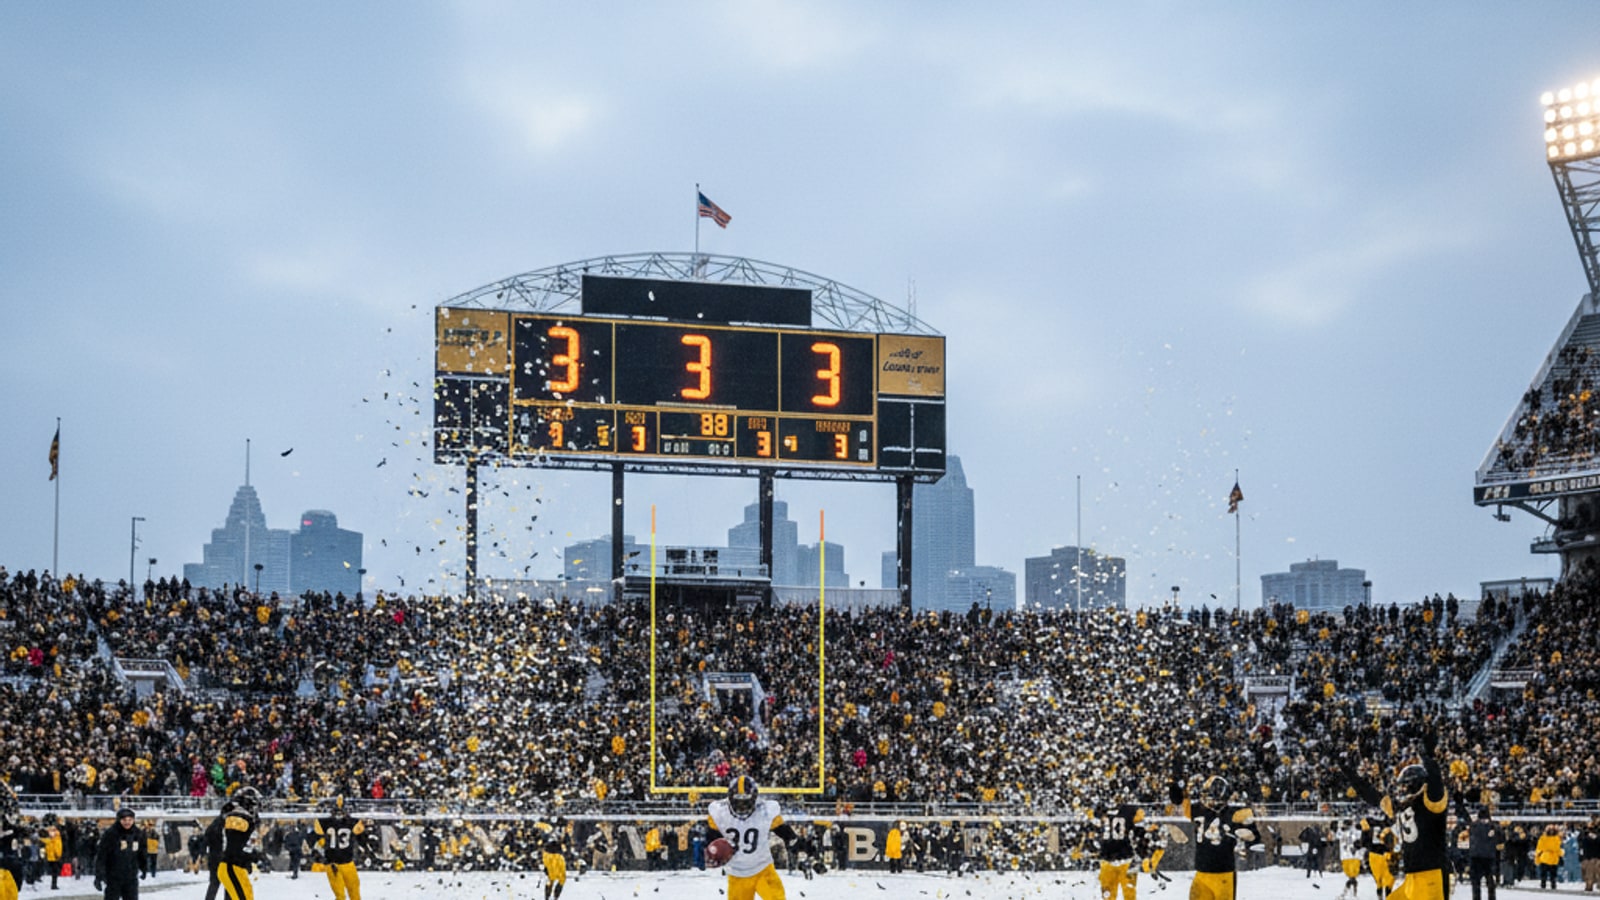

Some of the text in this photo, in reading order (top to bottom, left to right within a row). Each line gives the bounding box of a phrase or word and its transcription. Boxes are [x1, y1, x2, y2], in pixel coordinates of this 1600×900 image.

[547, 326, 580, 393] 3
[681, 334, 712, 399] 3
[811, 342, 841, 406] 3
[757, 431, 772, 457] 3
[834, 434, 849, 459] 3
[326, 826, 352, 850] 13
[725, 827, 760, 855] 39
